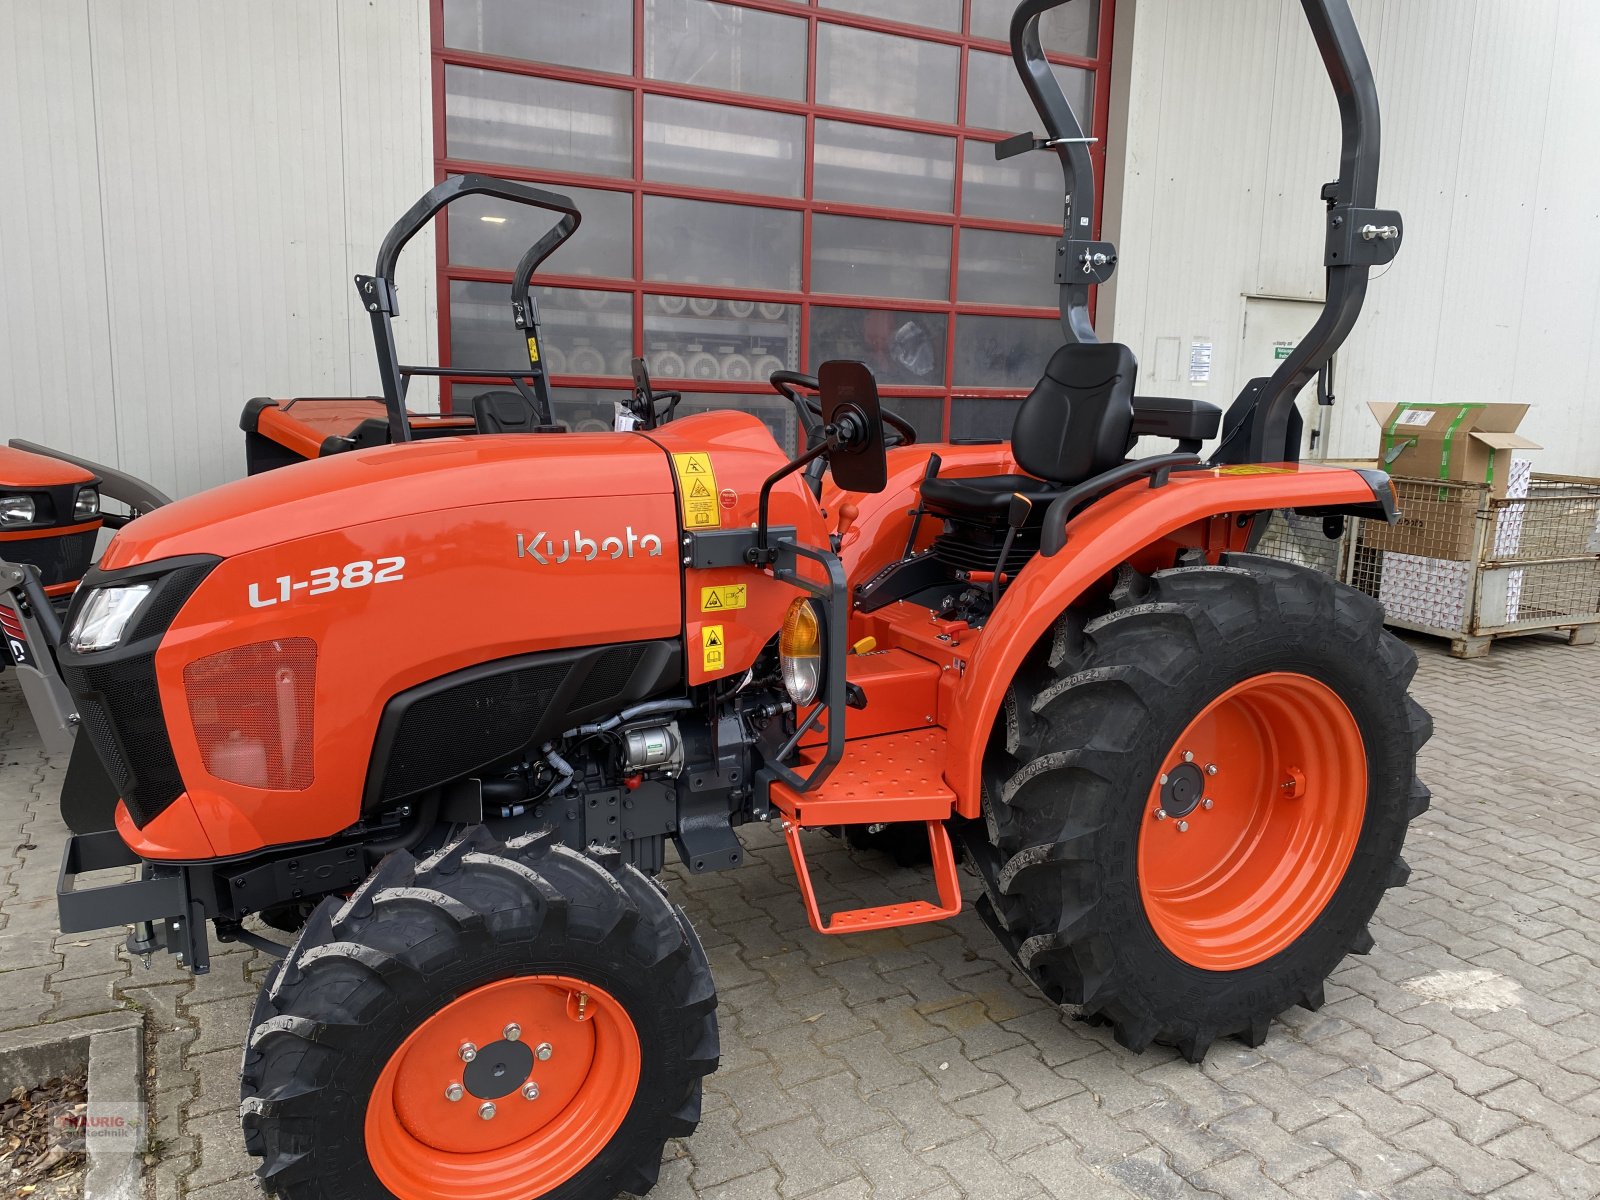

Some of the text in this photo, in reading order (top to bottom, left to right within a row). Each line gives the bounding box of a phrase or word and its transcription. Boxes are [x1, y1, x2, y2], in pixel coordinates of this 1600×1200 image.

[1396, 518, 1424, 527] ubota
[516, 526, 663, 565] Kubota
[248, 556, 406, 609] L1-382
[1044, 670, 1100, 699] 360/70R24
[1010, 757, 1055, 790] 360/70R24
